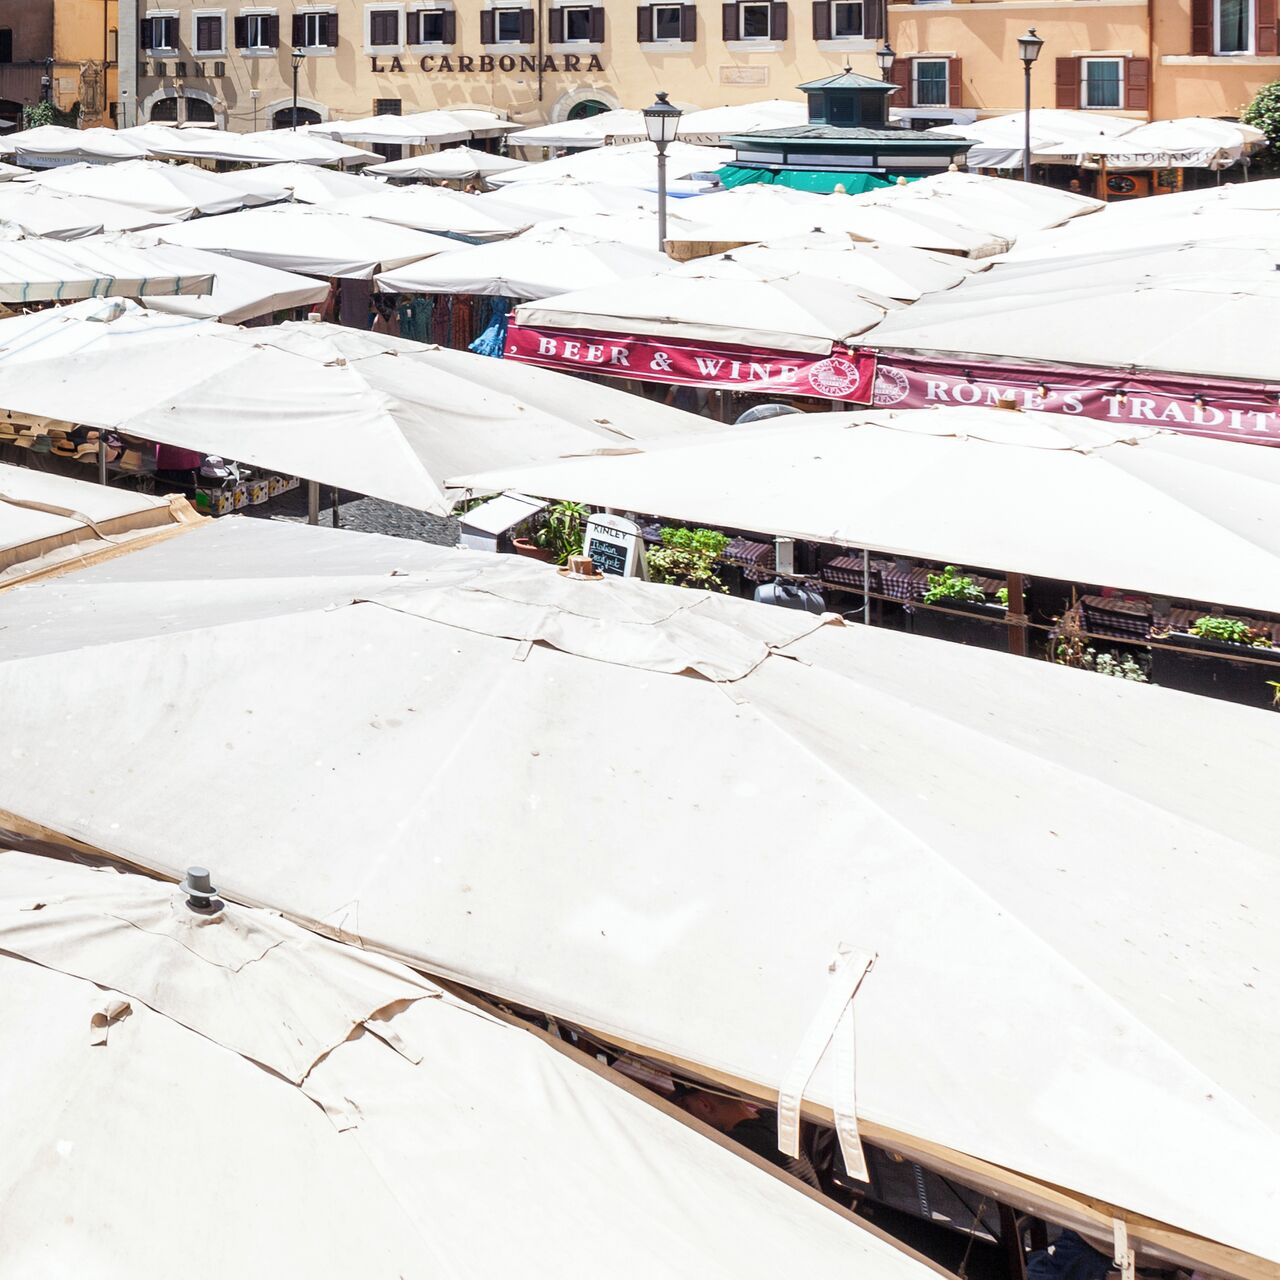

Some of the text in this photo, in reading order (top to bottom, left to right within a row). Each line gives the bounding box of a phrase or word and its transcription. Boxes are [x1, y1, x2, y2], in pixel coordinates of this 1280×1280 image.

[370, 54, 605, 73] LA CARBONARA
[538, 337, 631, 367] BEER
[650, 351, 674, 372] &
[694, 356, 800, 384] WINE
[925, 380, 1084, 415] ROME'S
[593, 524, 628, 540] KINLEY
